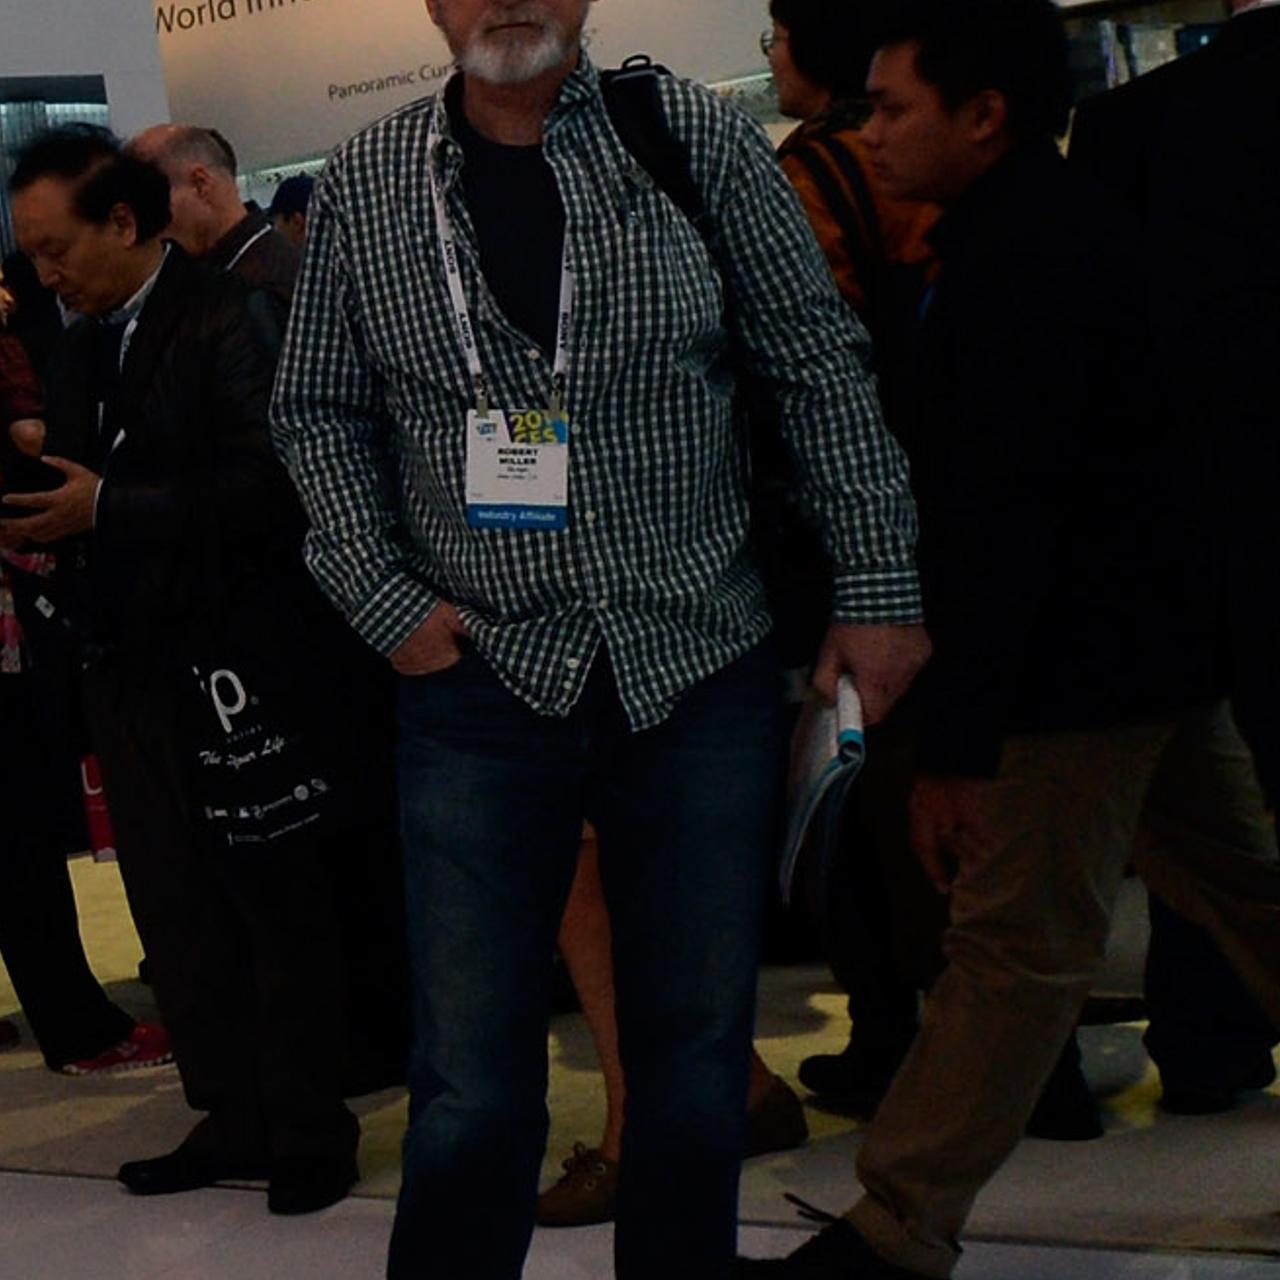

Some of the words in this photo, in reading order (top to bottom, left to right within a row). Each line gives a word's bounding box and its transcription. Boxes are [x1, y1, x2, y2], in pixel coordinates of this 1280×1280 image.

[327, 71, 416, 101] Panoramic
[497, 447, 539, 456] ROBERT
[498, 457, 537, 465] MILLER
[477, 510, 517, 522] Industry
